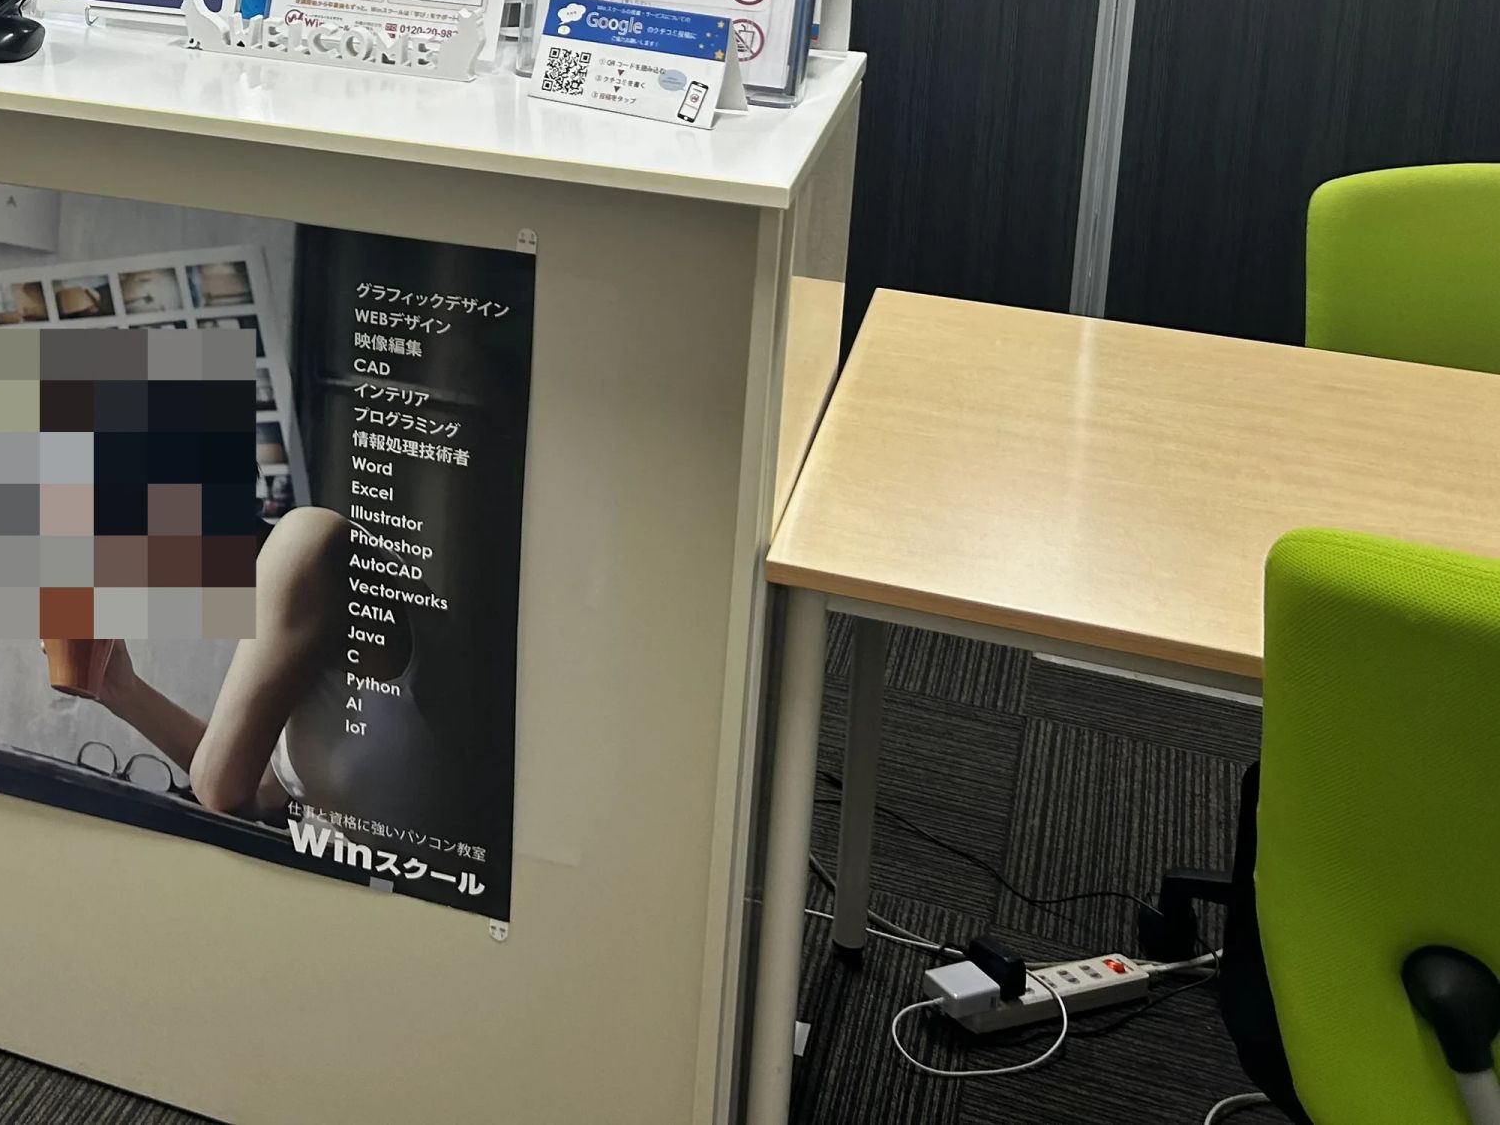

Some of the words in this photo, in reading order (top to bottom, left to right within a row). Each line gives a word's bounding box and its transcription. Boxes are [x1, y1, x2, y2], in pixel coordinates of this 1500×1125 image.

[586, 11, 643, 35] Google
[356, 282, 510, 318] グラフィックデザイン
[354, 308, 451, 334] WEBデザイン
[354, 332, 423, 357] 映像編集
[353, 358, 391, 375] CAD
[354, 383, 429, 407] インテリア
[354, 406, 461, 438] プログラミング
[352, 430, 471, 467] 情報処理技術者
[351, 455, 393, 476] Word
[351, 480, 394, 501] Excel
[350, 504, 423, 532] Illustrator
[350, 529, 433, 560] Photoshop
[349, 553, 423, 580] AutoCAD
[349, 577, 449, 611] Vectorworks
[348, 602, 396, 624] CATIA
[347, 625, 386, 646] Java
[347, 649, 360, 664] C
[346, 672, 401, 697] Python
[346, 697, 362, 712] AI
[345, 719, 367, 736] IoT
[287, 800, 487, 863] 仕事と資格に強いパソコン教室
[287, 818, 486, 896] Winスクール
